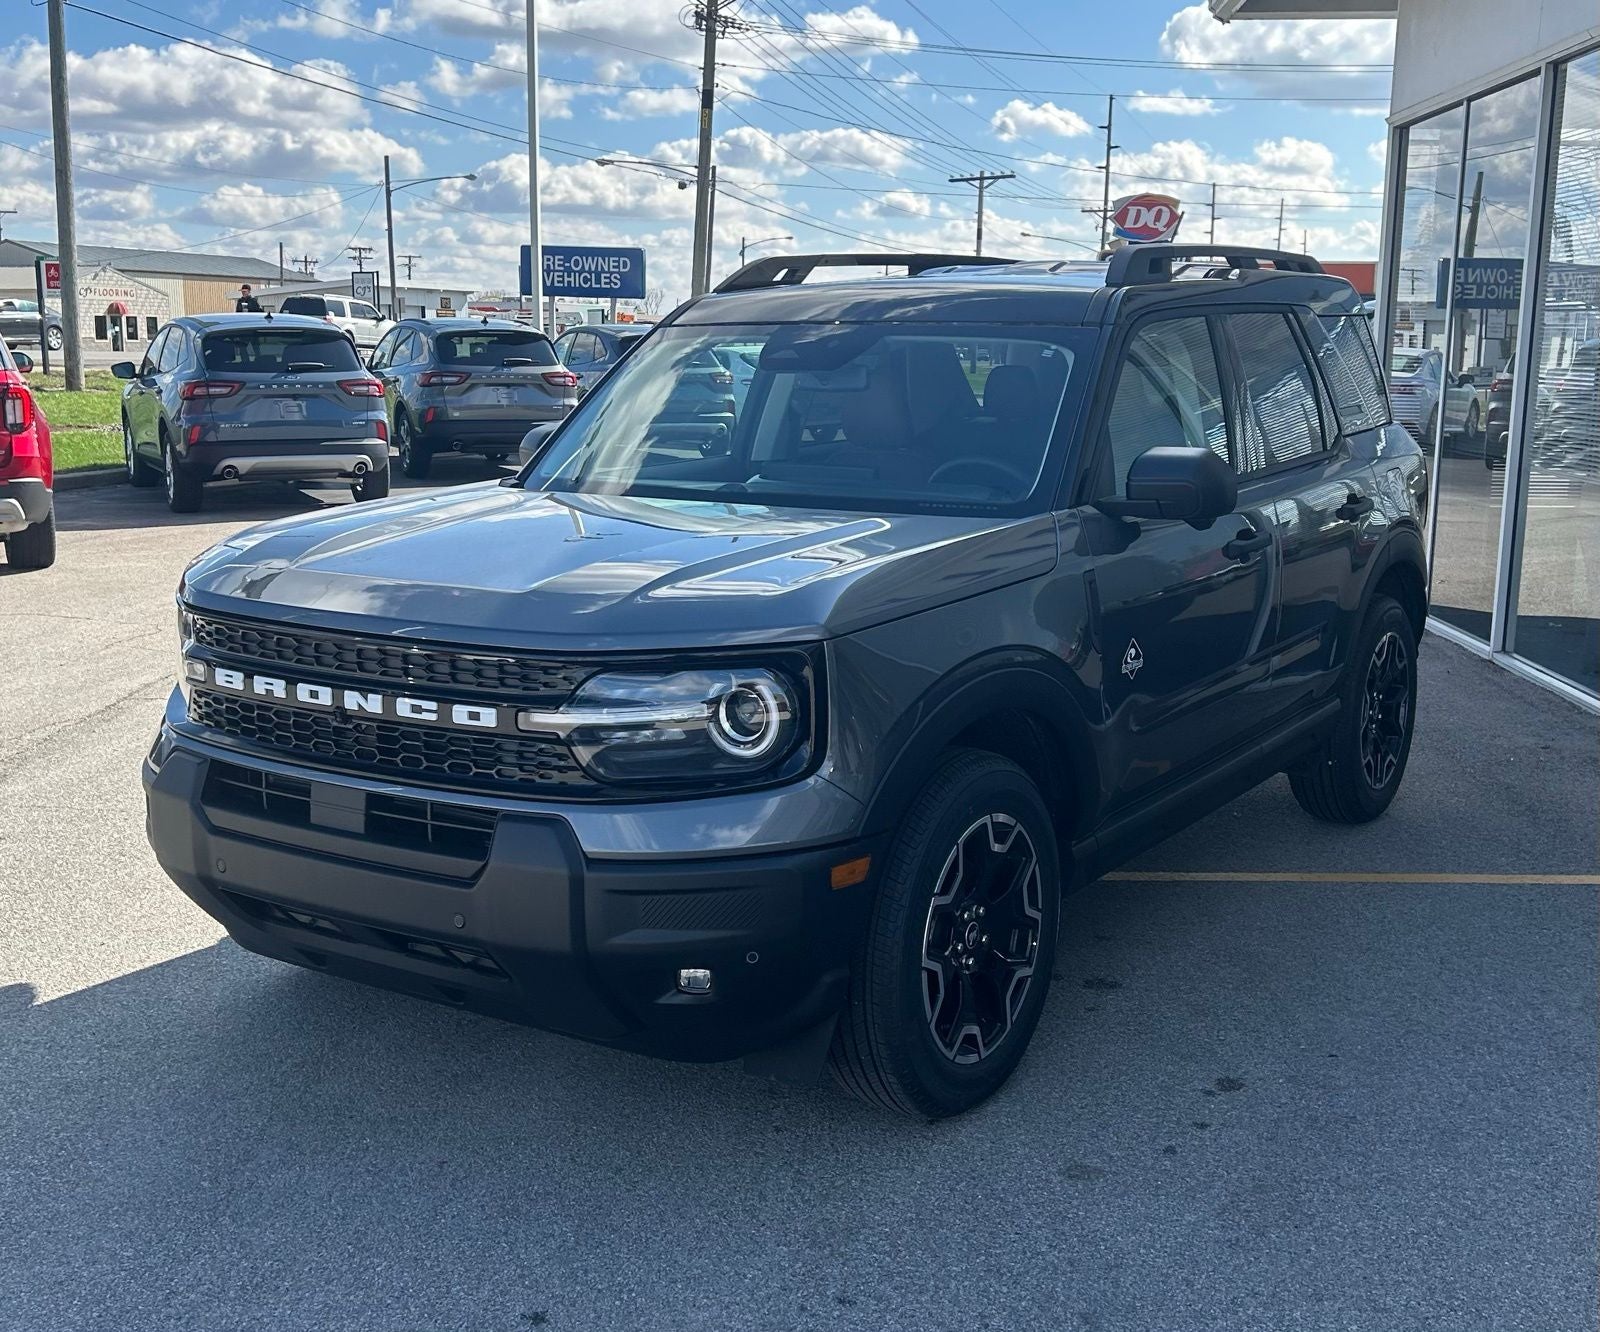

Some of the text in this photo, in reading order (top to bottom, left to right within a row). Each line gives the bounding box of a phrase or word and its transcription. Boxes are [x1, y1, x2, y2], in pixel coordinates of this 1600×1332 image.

[1124, 205, 1170, 231] DQ
[543, 255, 631, 272] RE-OWNED
[543, 272, 621, 288] VEHICLES
[94, 288, 135, 298] FLOORING
[214, 667, 498, 728] BRONCO
